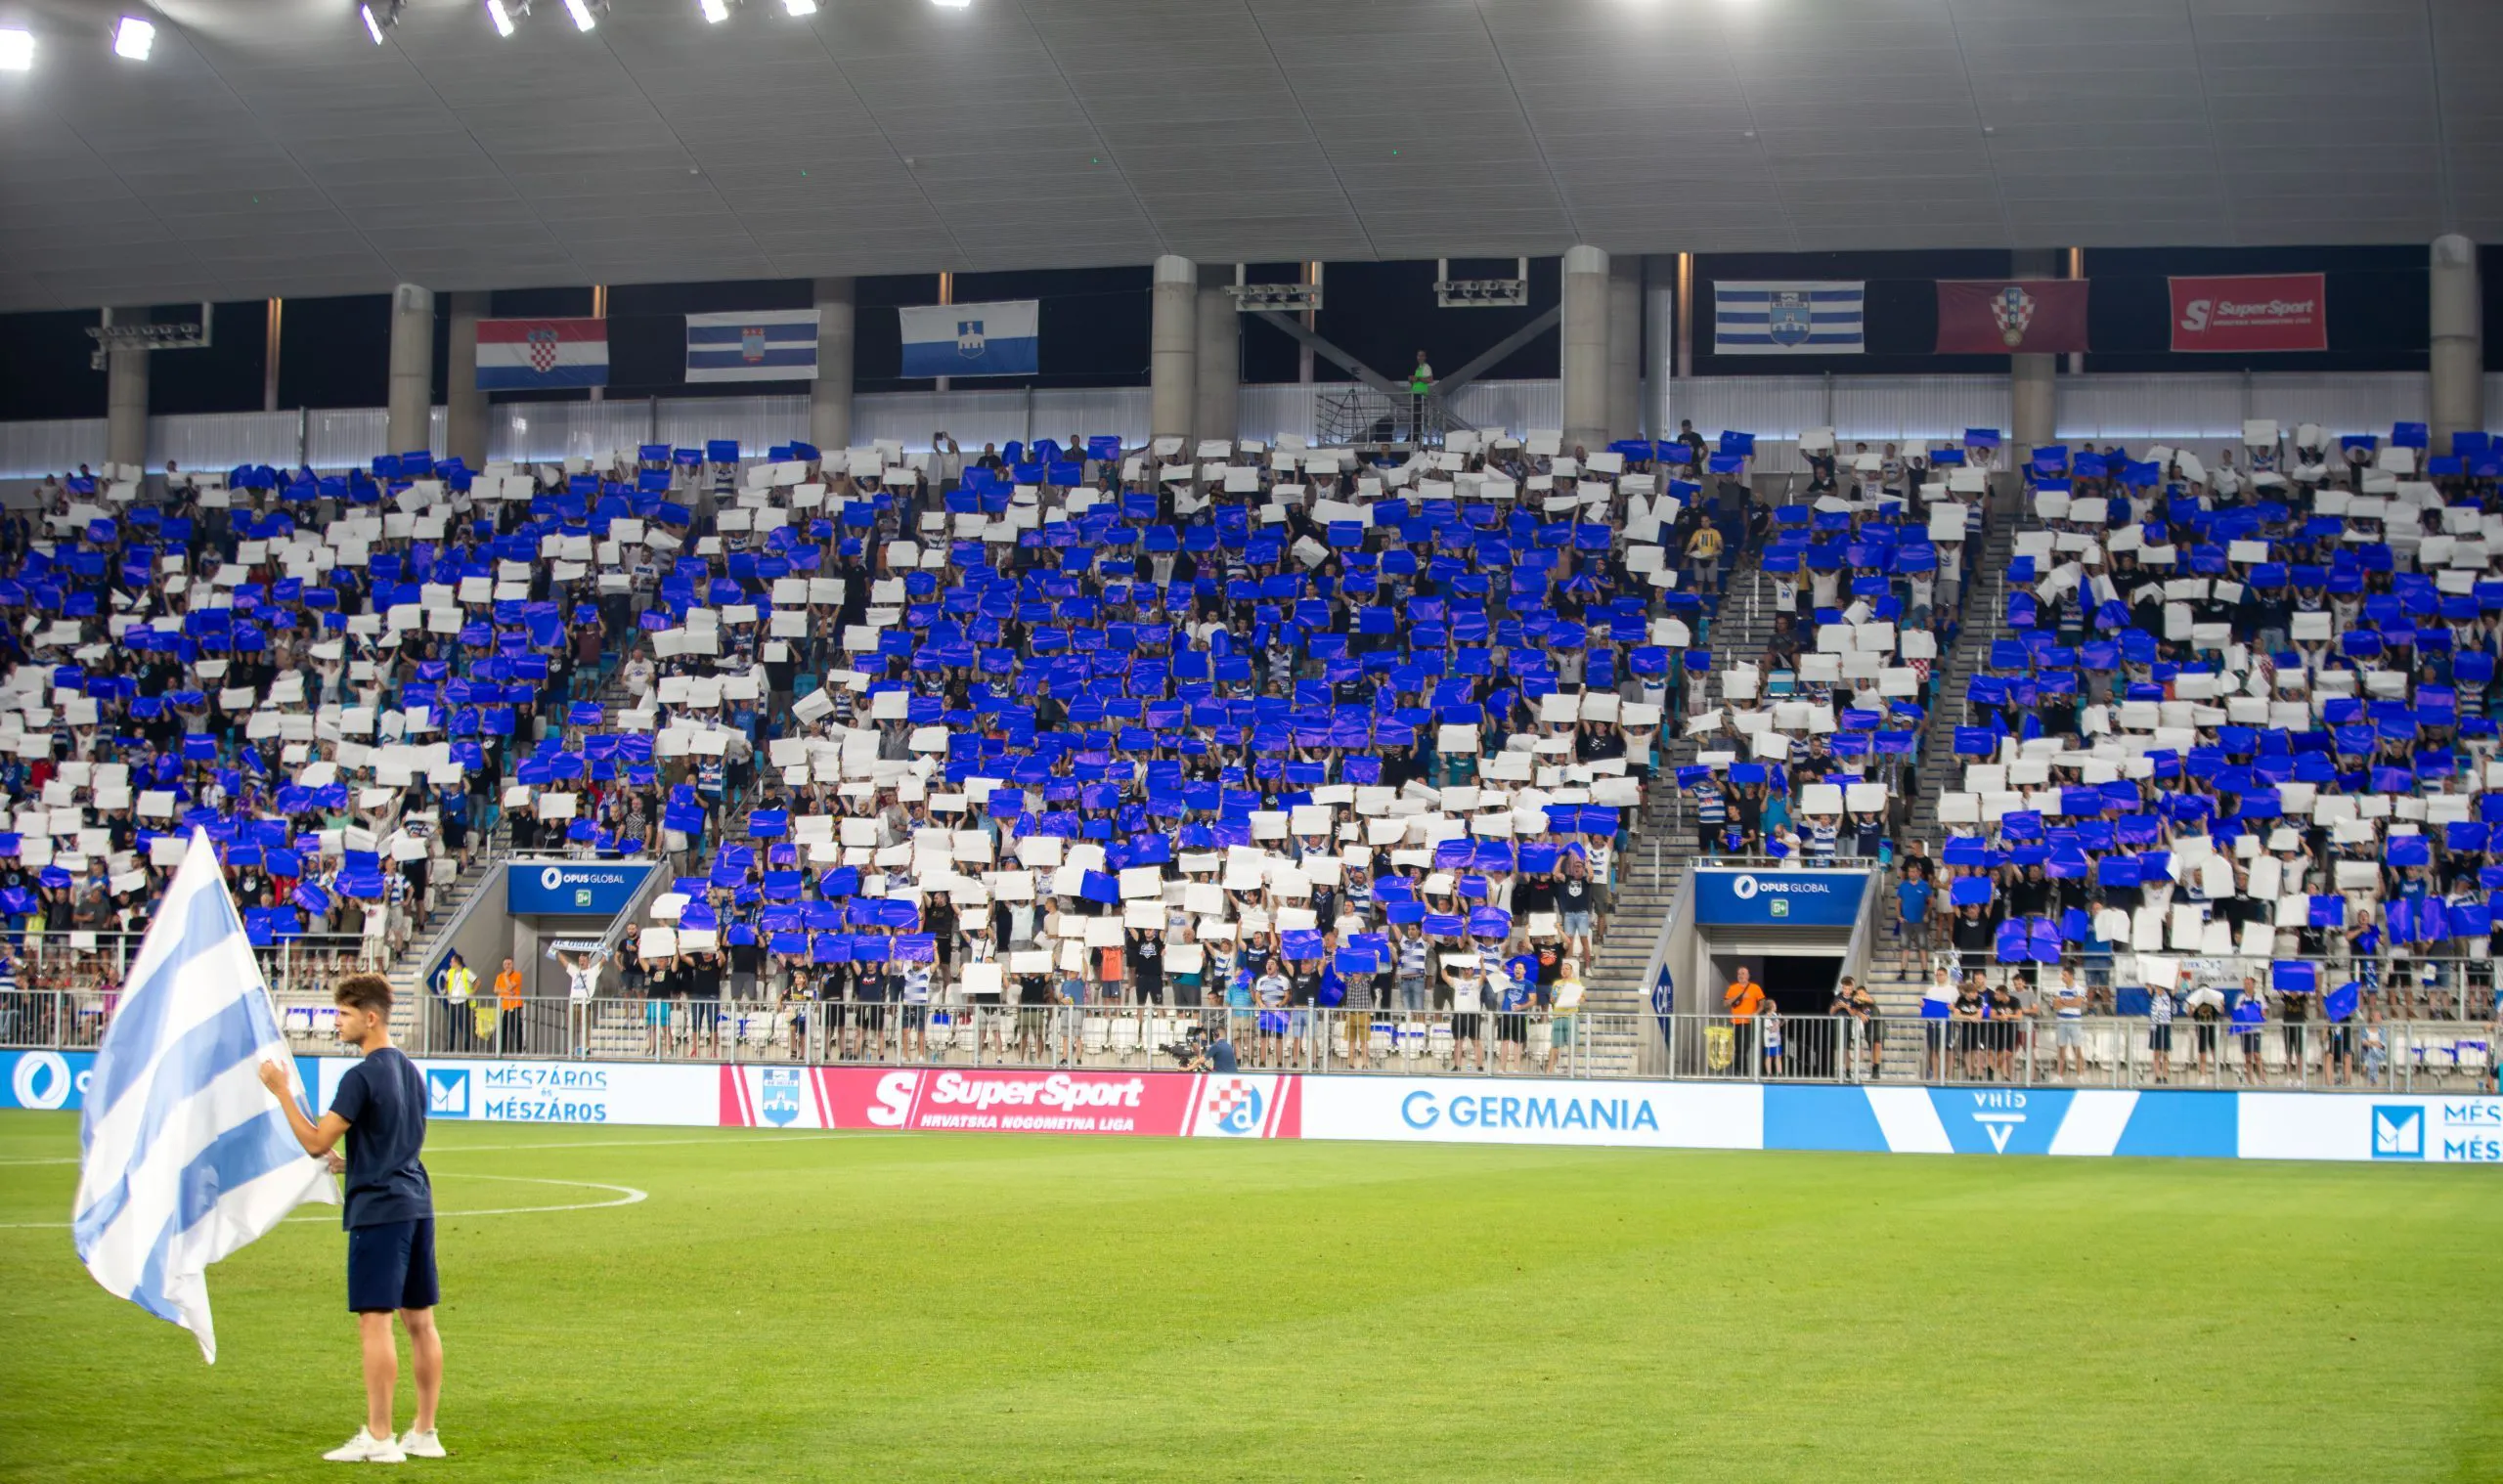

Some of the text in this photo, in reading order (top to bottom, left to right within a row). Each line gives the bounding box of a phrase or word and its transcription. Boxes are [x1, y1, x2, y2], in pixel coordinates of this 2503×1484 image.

[2217, 299, 2314, 317] SuperSport
[563, 873, 625, 884] OPUS GLOBAL
[1760, 883, 1830, 894] OPUS GLOBAL
[931, 1071, 1144, 1111] SuperSport
[485, 1096, 607, 1122] MÉSZÁROS
[1449, 1095, 1659, 1131] GERMANIA
[920, 1114, 1134, 1131] HRVATSKA NOGOMETNA LIGA
